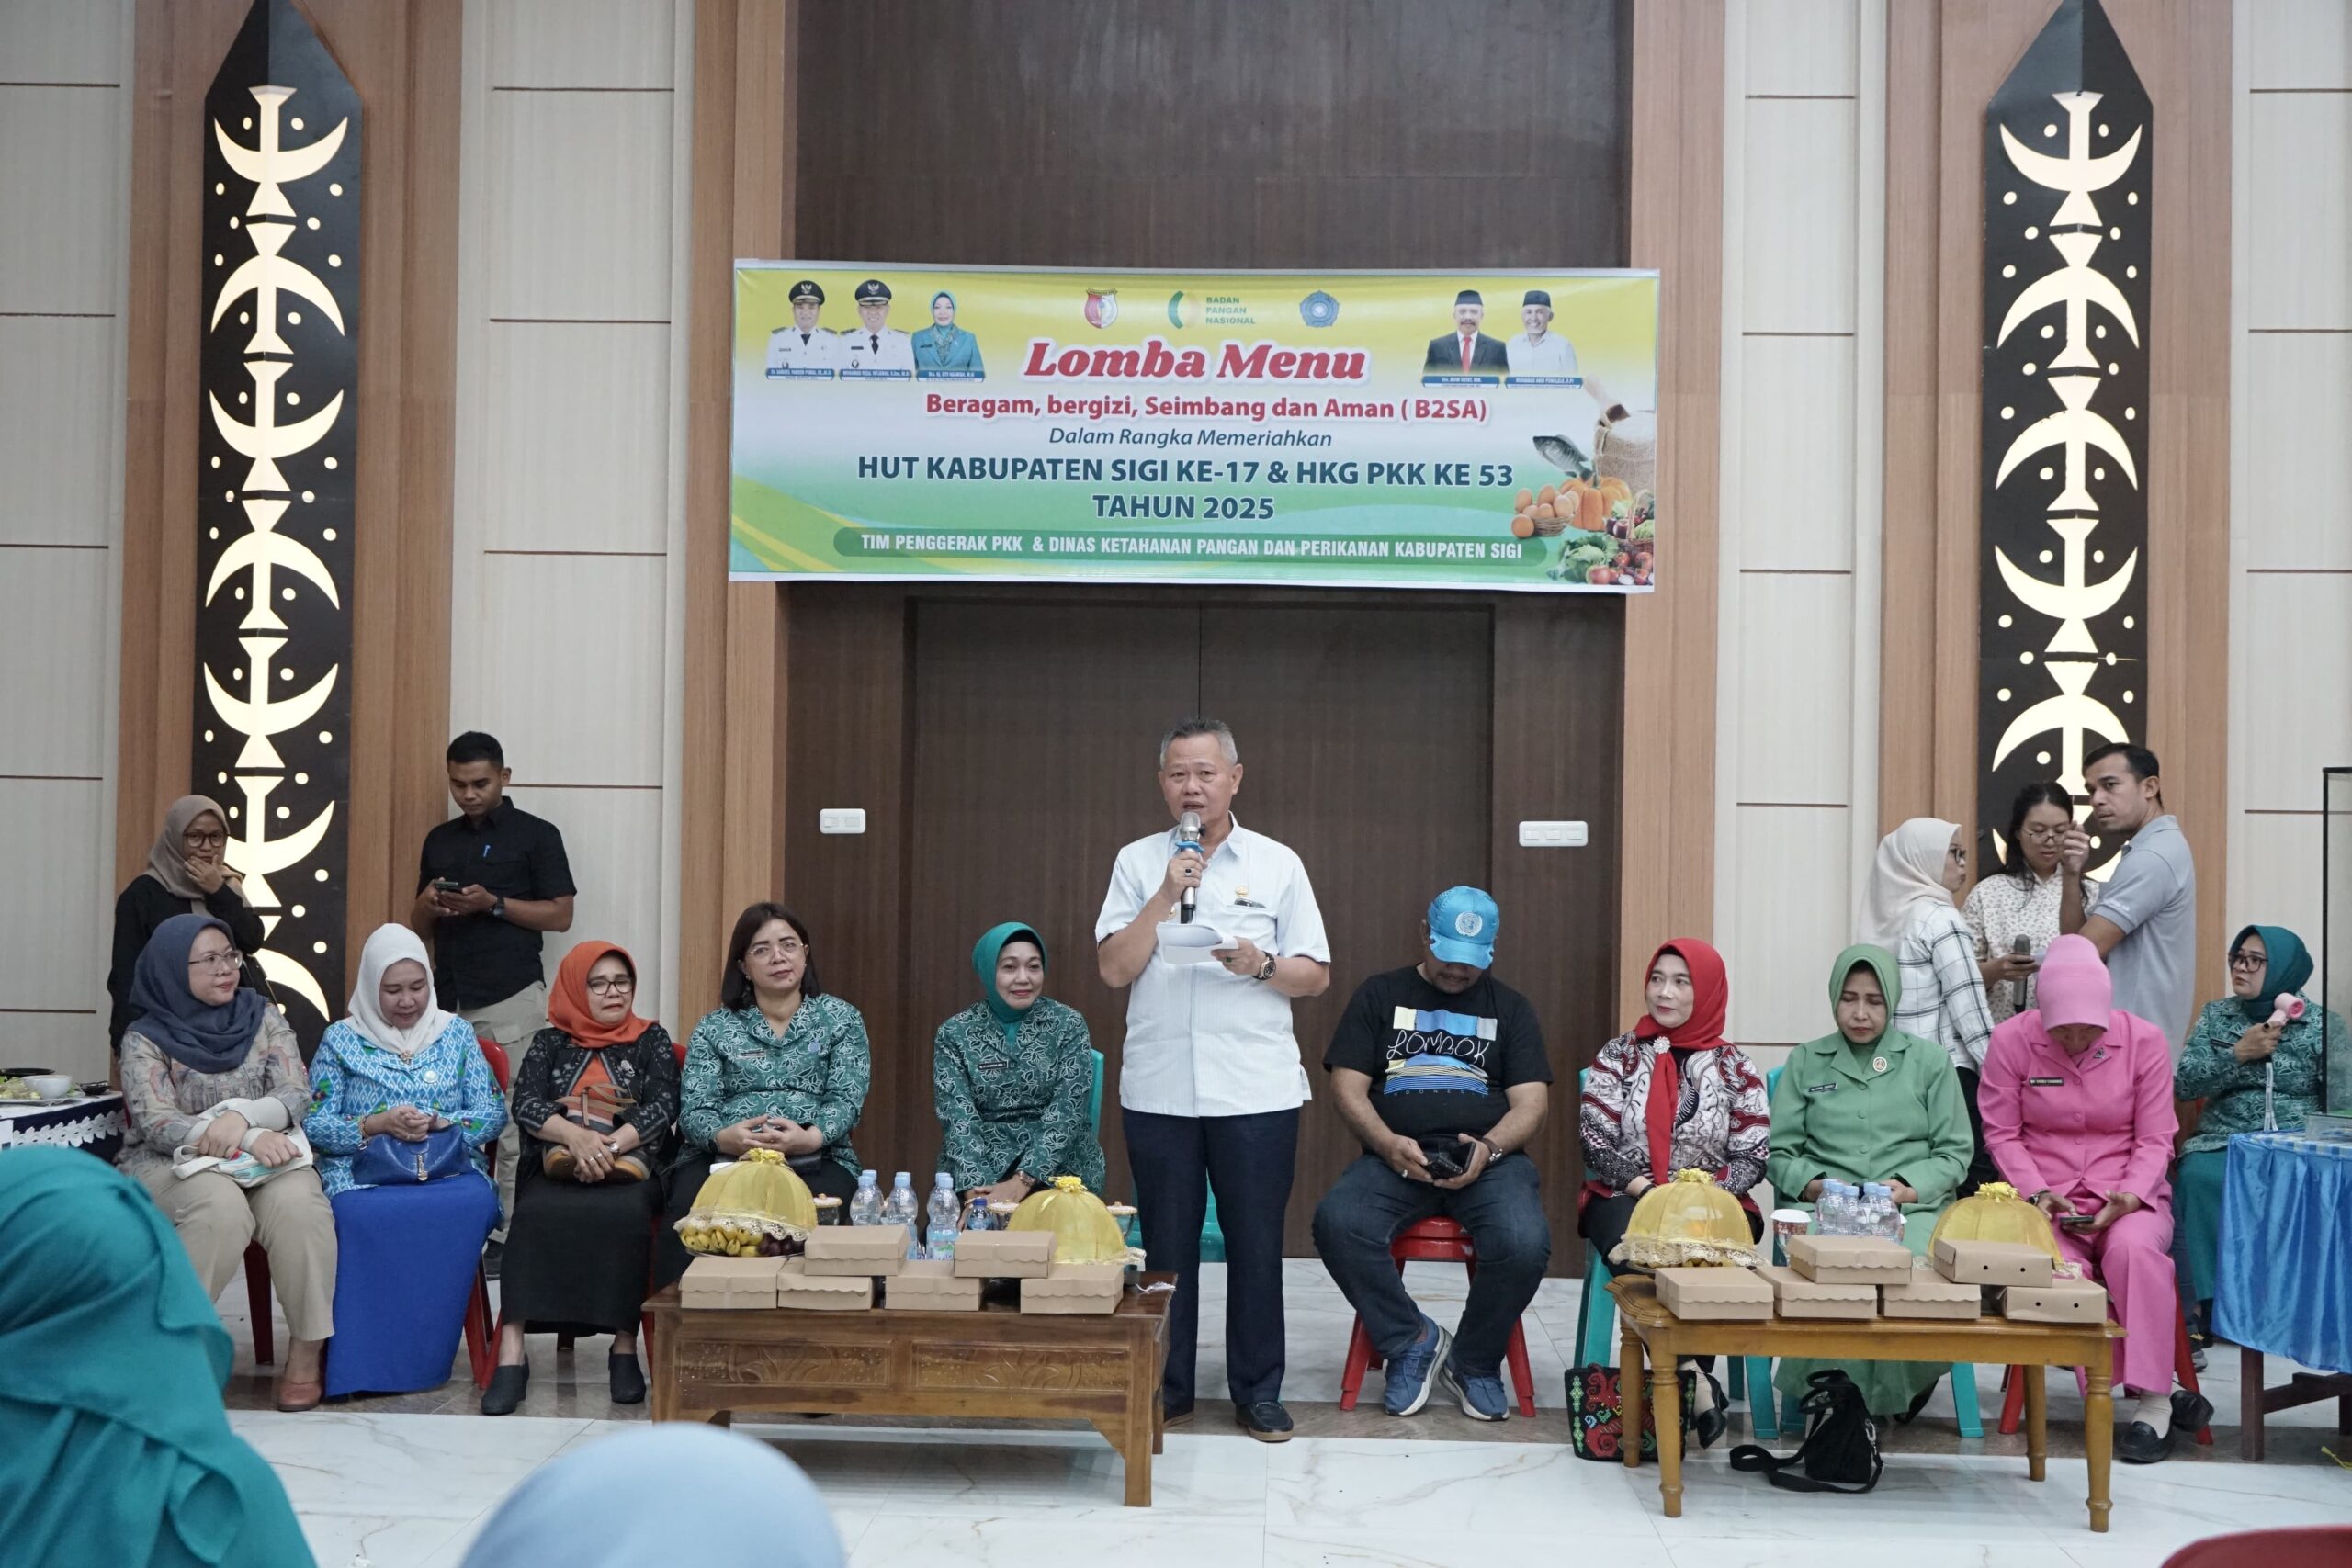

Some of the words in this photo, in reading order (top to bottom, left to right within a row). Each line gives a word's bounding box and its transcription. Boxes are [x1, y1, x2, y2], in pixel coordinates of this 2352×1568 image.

[1024, 340, 1205, 378] Lomba
[1216, 344, 1365, 379] Menu
[926, 394, 1041, 418] Beragam,
[1047, 395, 1137, 419] bergizi,
[1145, 396, 1265, 421] Seimbang
[1272, 398, 1317, 417] dan
[1323, 399, 1394, 418] Aman
[1049, 427, 1114, 445] Dalam
[1120, 429, 1193, 448] Rangka
[1197, 430, 1332, 446] Memeriahkan
[858, 457, 919, 479] HUT
[927, 457, 1102, 480] KABUPATEN
[1111, 459, 1167, 482] SIGI
[1177, 460, 1260, 483] KE-17
[1267, 461, 1289, 484] &
[1296, 462, 1359, 485] HKG
[1367, 463, 1426, 485] PKK
[1434, 464, 1470, 486] KE
[1478, 464, 1513, 487] 53
[1092, 494, 1194, 518] TAHUN
[1203, 497, 1274, 520] 2025
[861, 535, 889, 550] TIM
[896, 535, 987, 551] PENGGERAK
[992, 536, 1022, 551] PKK
[1033, 536, 1044, 552] &
[1049, 536, 1096, 552] DINAS
[1101, 537, 1191, 554] KETAHANAN
[1197, 539, 1258, 555] PANGAN
[1264, 540, 1295, 556] DAN
[1301, 540, 1389, 557] PERIKANAN
[1395, 542, 1486, 558] KABUPATEN
[1491, 543, 1522, 558] SIGI
[1386, 1029, 1490, 1067] LOMBOK
